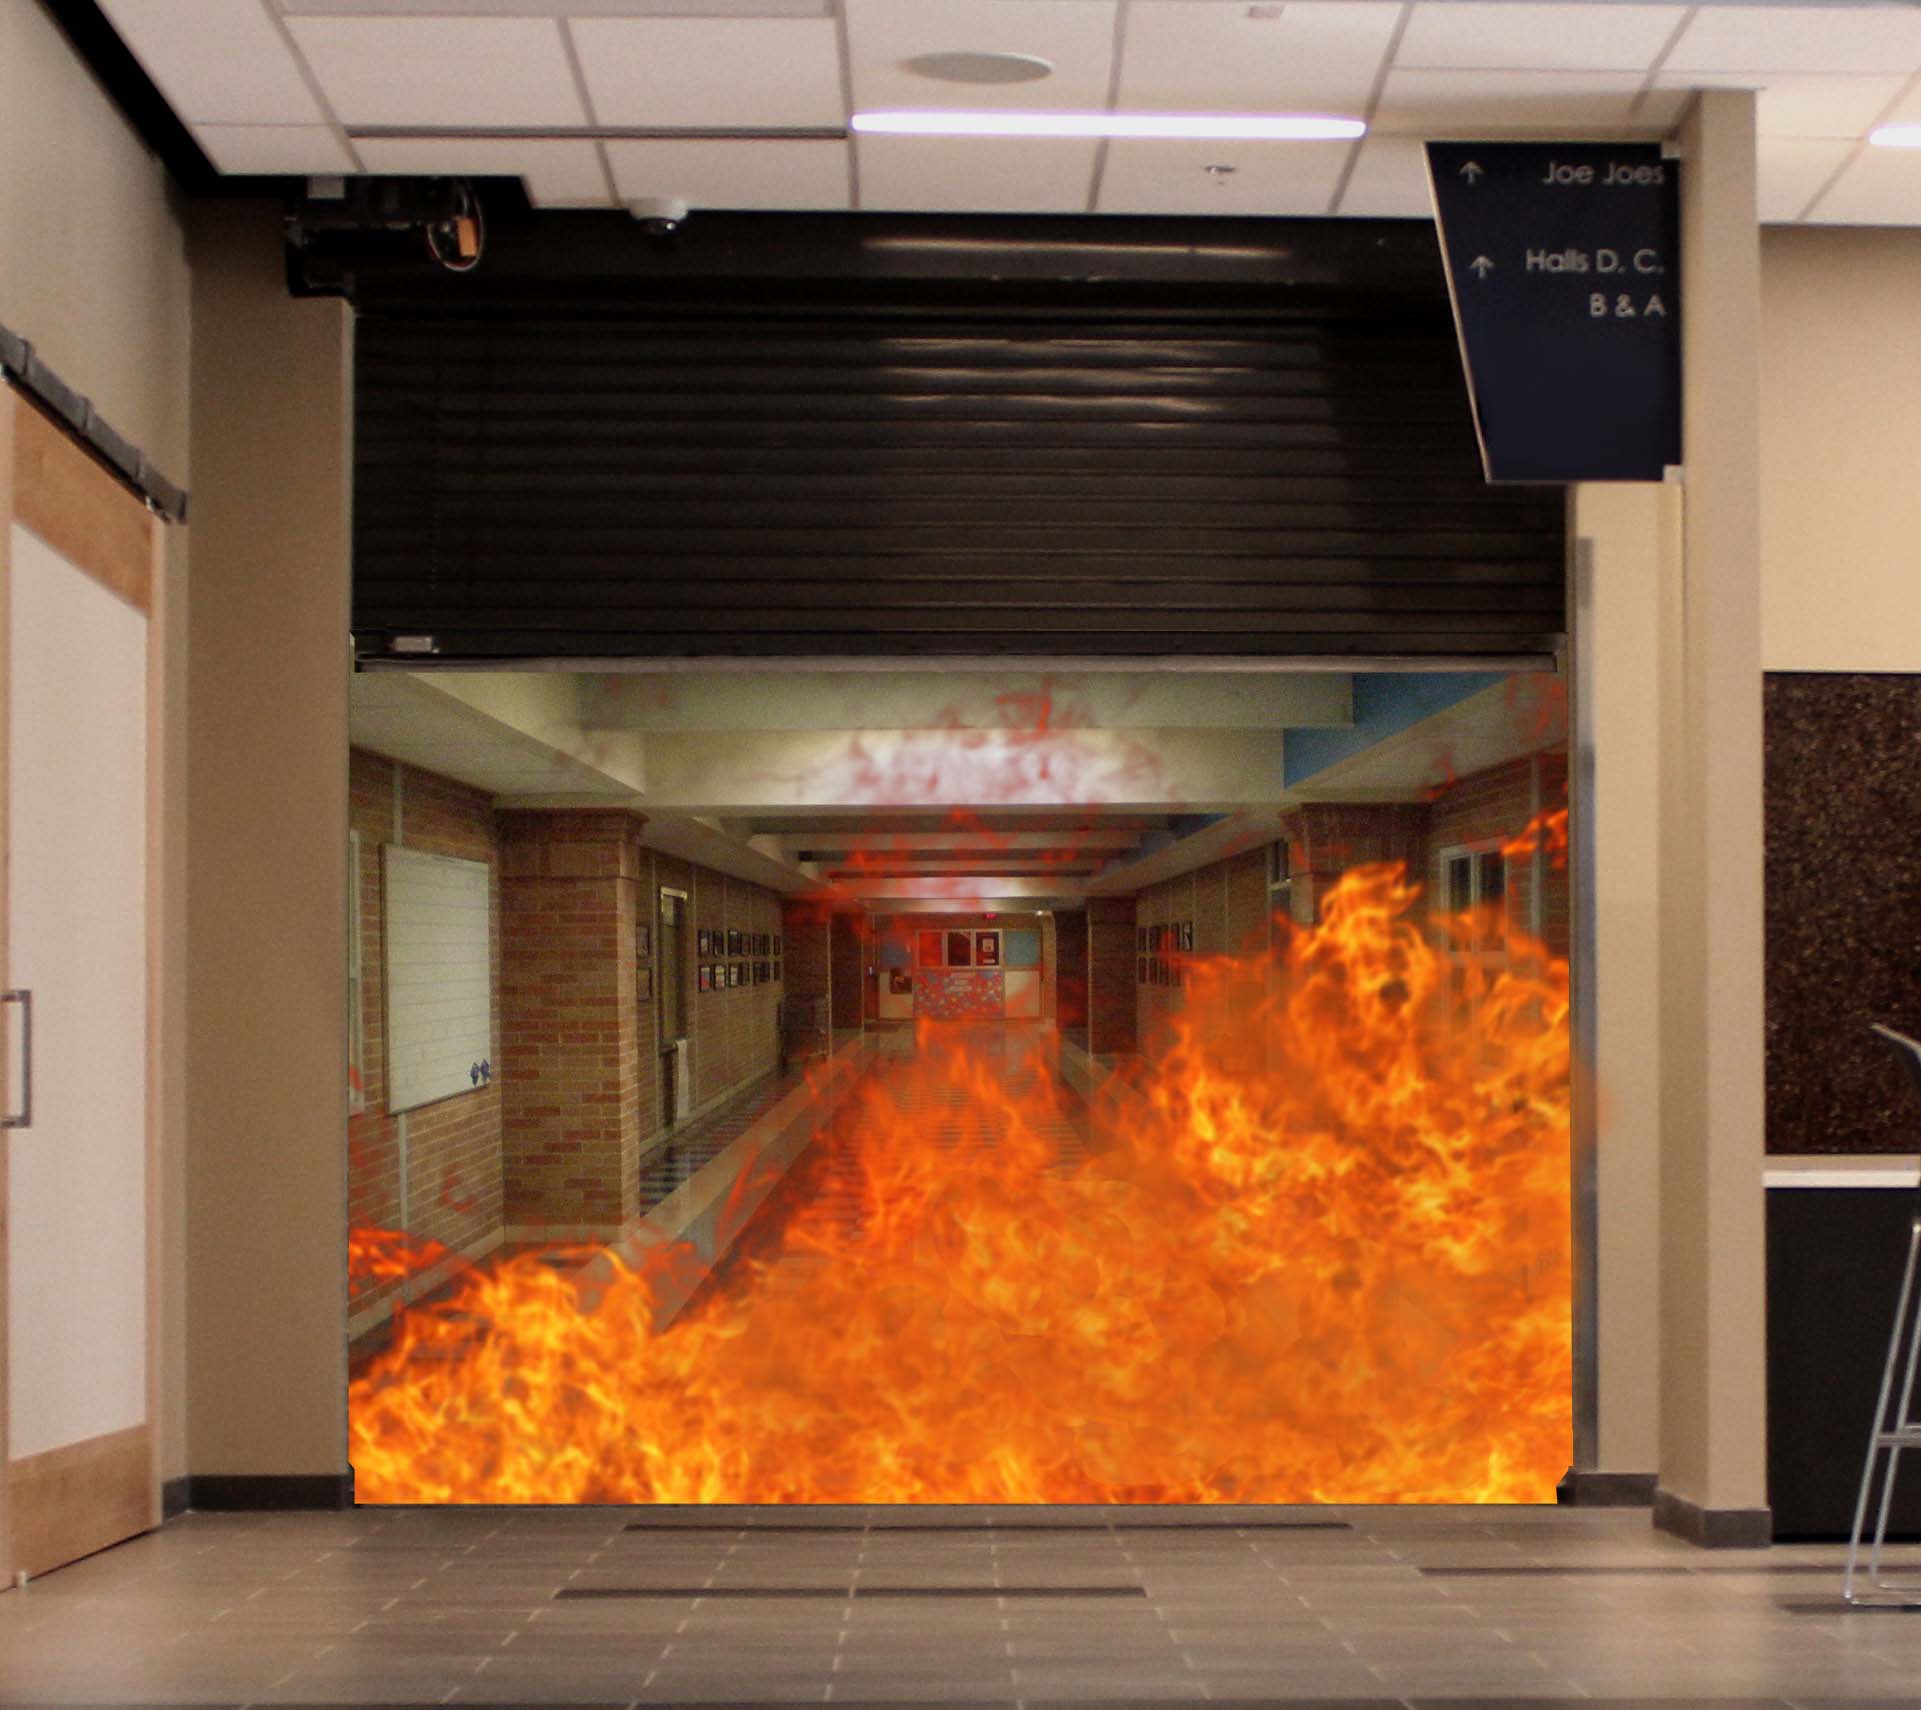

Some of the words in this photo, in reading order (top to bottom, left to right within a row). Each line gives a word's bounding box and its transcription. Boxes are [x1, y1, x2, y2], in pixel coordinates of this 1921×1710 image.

[1542, 161, 1594, 184] Joe
[1602, 161, 1664, 184] Joes
[1525, 248, 1589, 273] Halls
[1589, 292, 1608, 318] B
[1614, 293, 1636, 318] &
[1643, 294, 1667, 317] A
